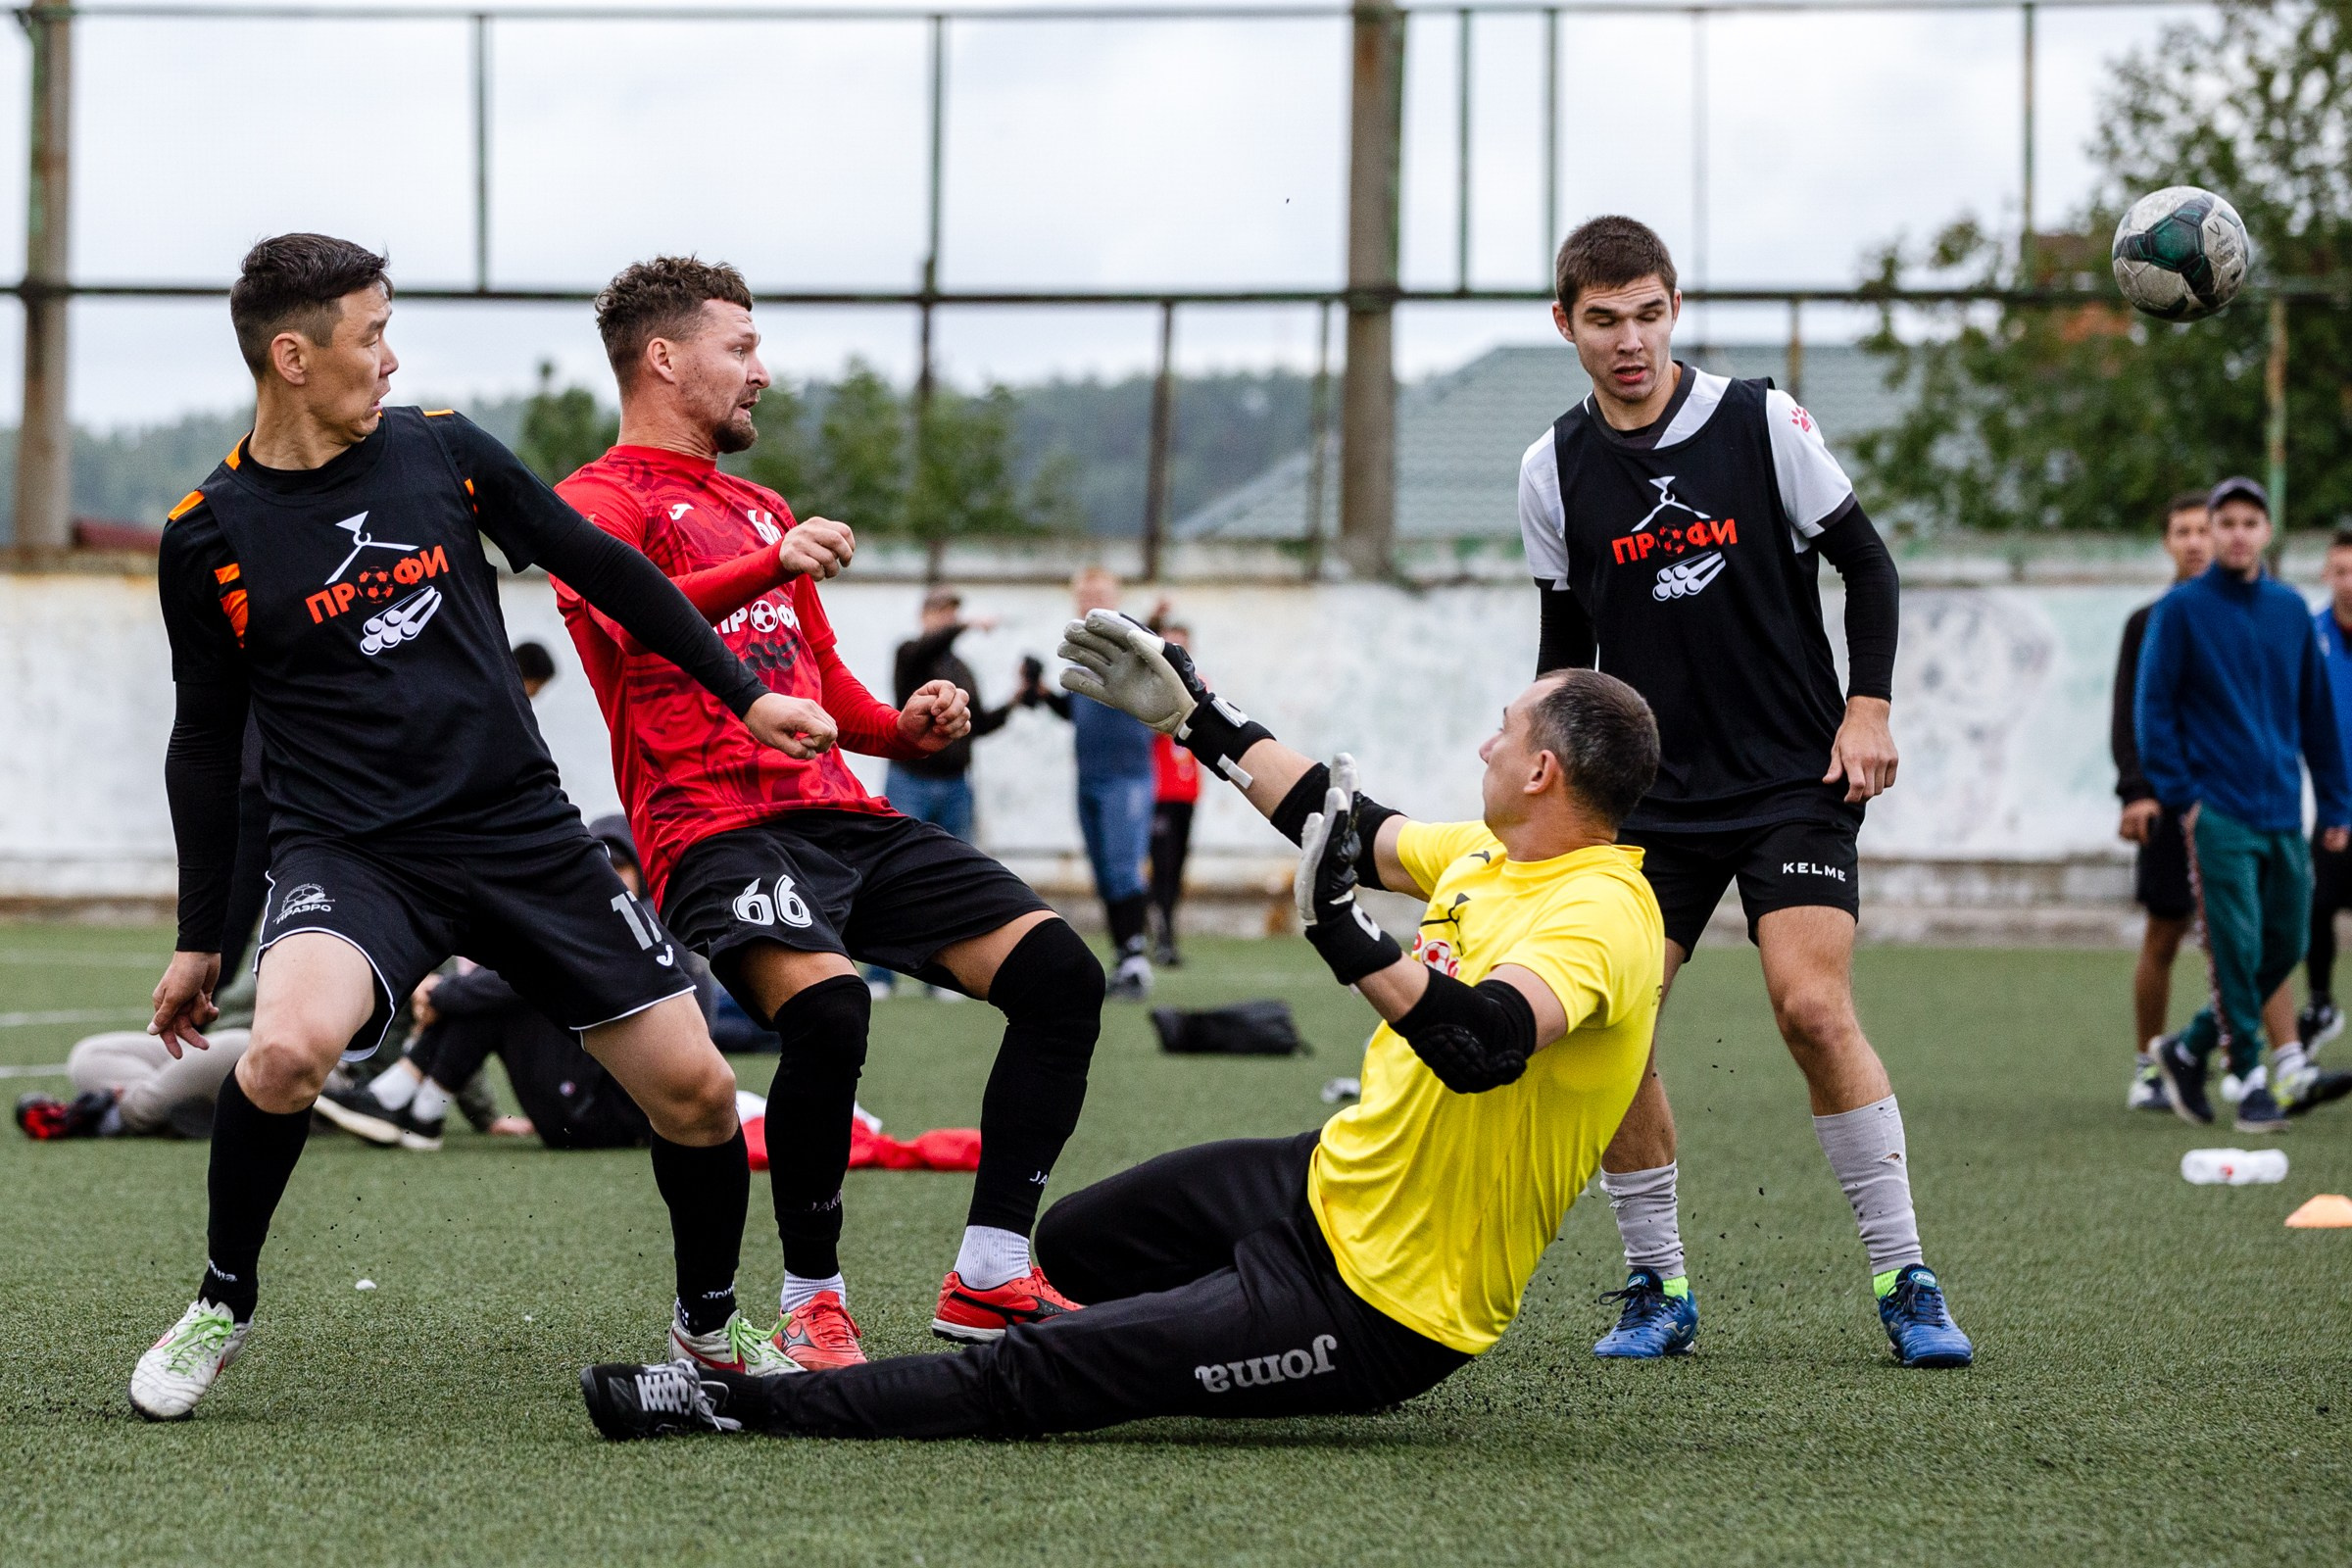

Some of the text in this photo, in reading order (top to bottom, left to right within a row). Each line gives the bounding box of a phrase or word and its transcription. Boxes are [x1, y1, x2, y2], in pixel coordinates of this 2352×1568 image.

[747, 509, 783, 546] 66
[1612, 518, 1738, 564] ПРОФИ
[306, 545, 450, 624] ПРОФИ
[1783, 862, 1846, 883] KELME
[732, 874, 813, 929] 66
[1195, 1334, 1338, 1393] Joma
